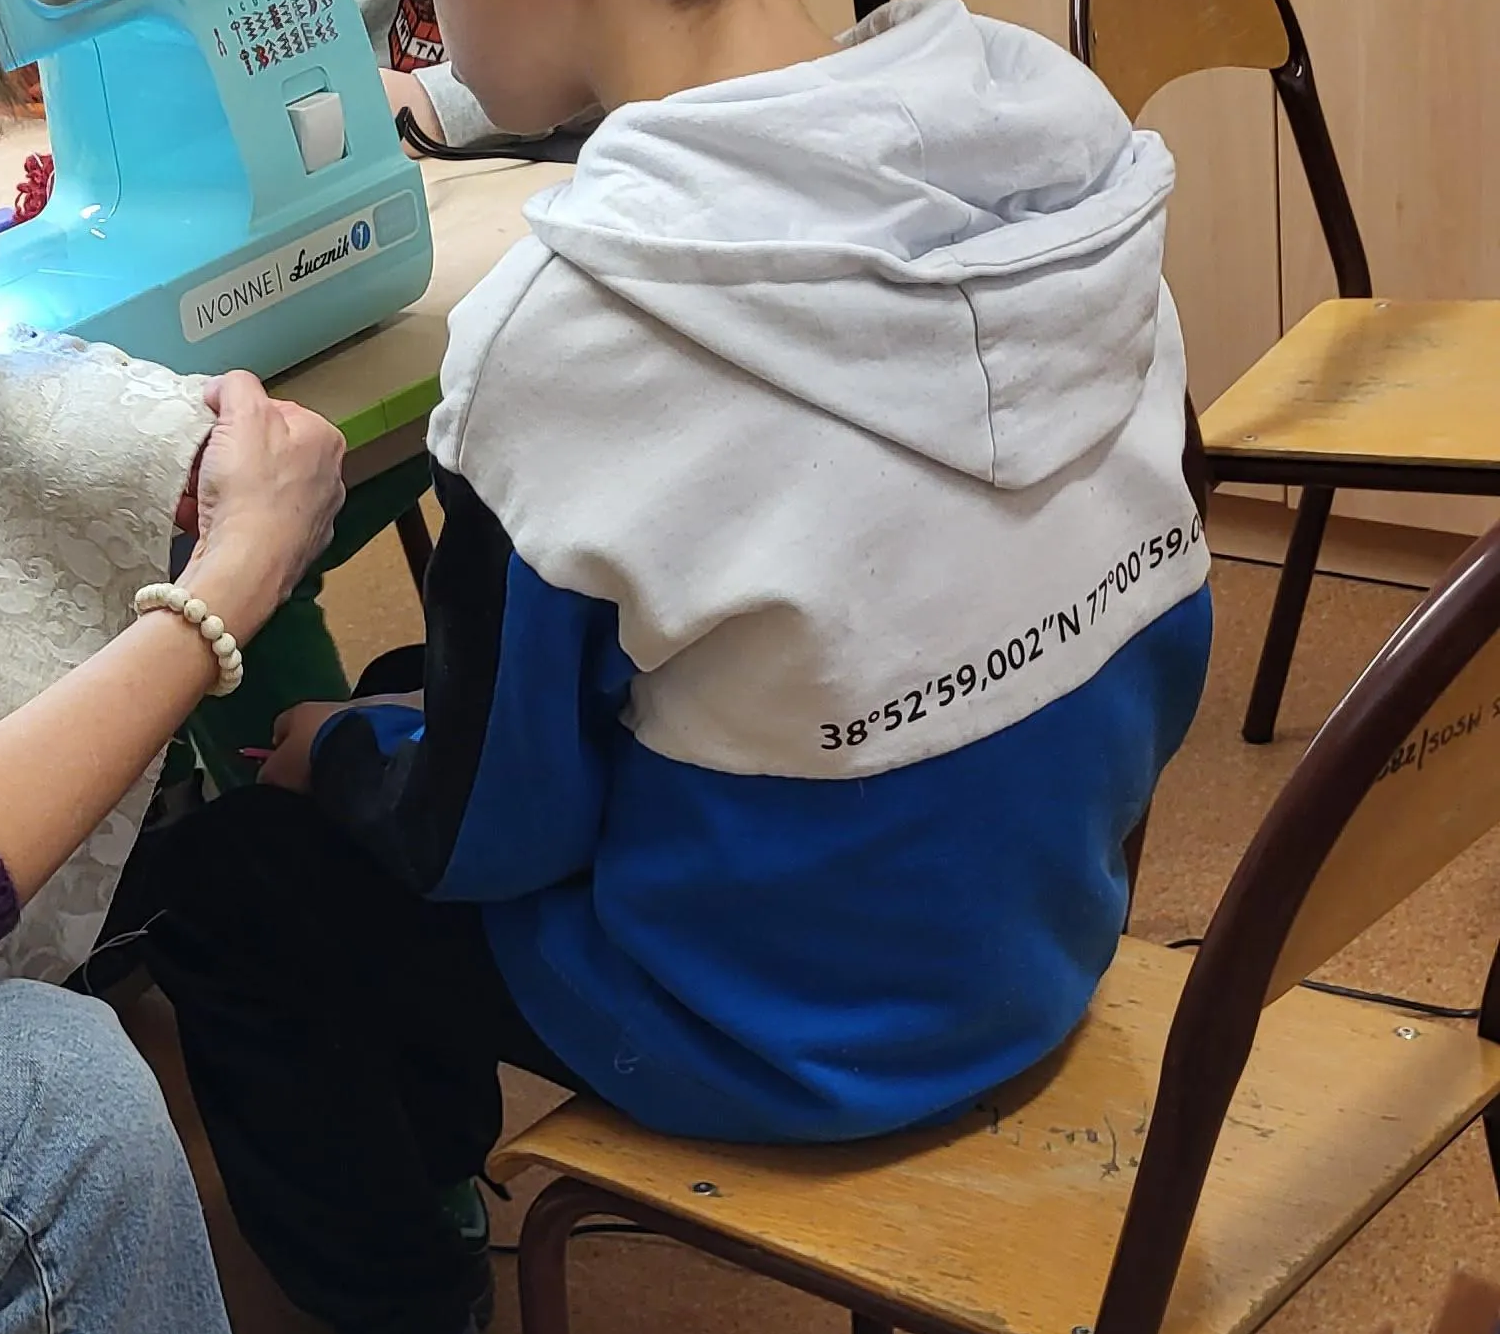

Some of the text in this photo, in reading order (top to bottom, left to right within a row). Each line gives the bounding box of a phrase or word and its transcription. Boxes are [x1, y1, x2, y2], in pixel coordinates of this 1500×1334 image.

[415, 41, 445, 62] TN
[196, 270, 275, 329] IVONNE
[1086, 513, 1202, 625] 77°00'59,0
